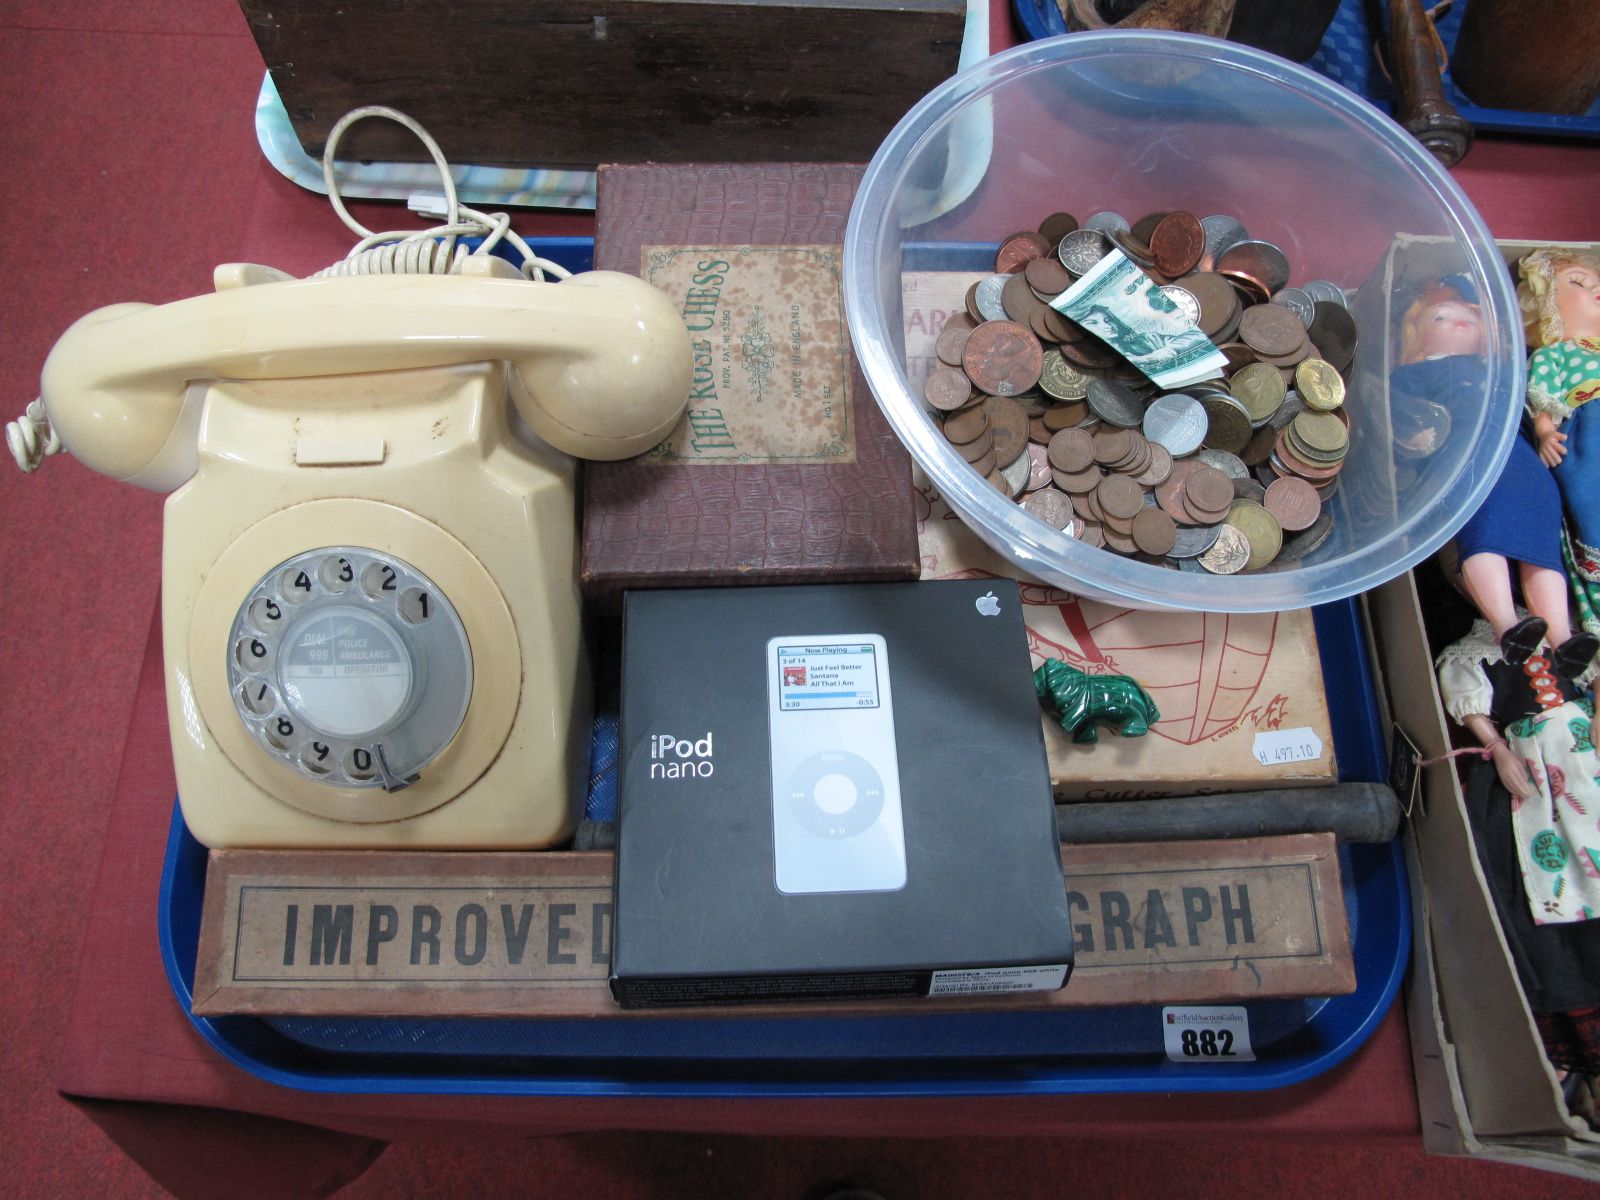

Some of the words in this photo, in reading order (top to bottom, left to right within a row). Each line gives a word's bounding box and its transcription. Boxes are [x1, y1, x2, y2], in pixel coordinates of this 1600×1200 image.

[682, 260, 730, 332] CHESS
[722, 309, 731, 331] 5280
[791, 304, 801, 351] ENGLAND
[791, 355, 801, 365] IN
[791, 371, 802, 400] MADE
[688, 408, 737, 453] THE
[294, 571, 312, 592] 4
[338, 558, 354, 583] 3
[381, 565, 397, 591] 2
[266, 599, 282, 620] 5
[418, 592, 429, 618] 1
[250, 639, 267, 658] 6
[309, 649, 329, 661] 999
[340, 649, 393, 660] AMBULANCE
[823, 646, 848, 655] Playing
[313, 741, 330, 762] 9
[651, 732, 713, 759] iPod
[1259, 751, 1268, 764] H
[1275, 744, 1314, 761] 497.10
[353, 748, 372, 771] 0
[651, 761, 713, 779] nano
[283, 903, 614, 966] IMPROVED
[1066, 884, 1256, 953] GRAPH
[1181, 1028, 1237, 1057] 882
